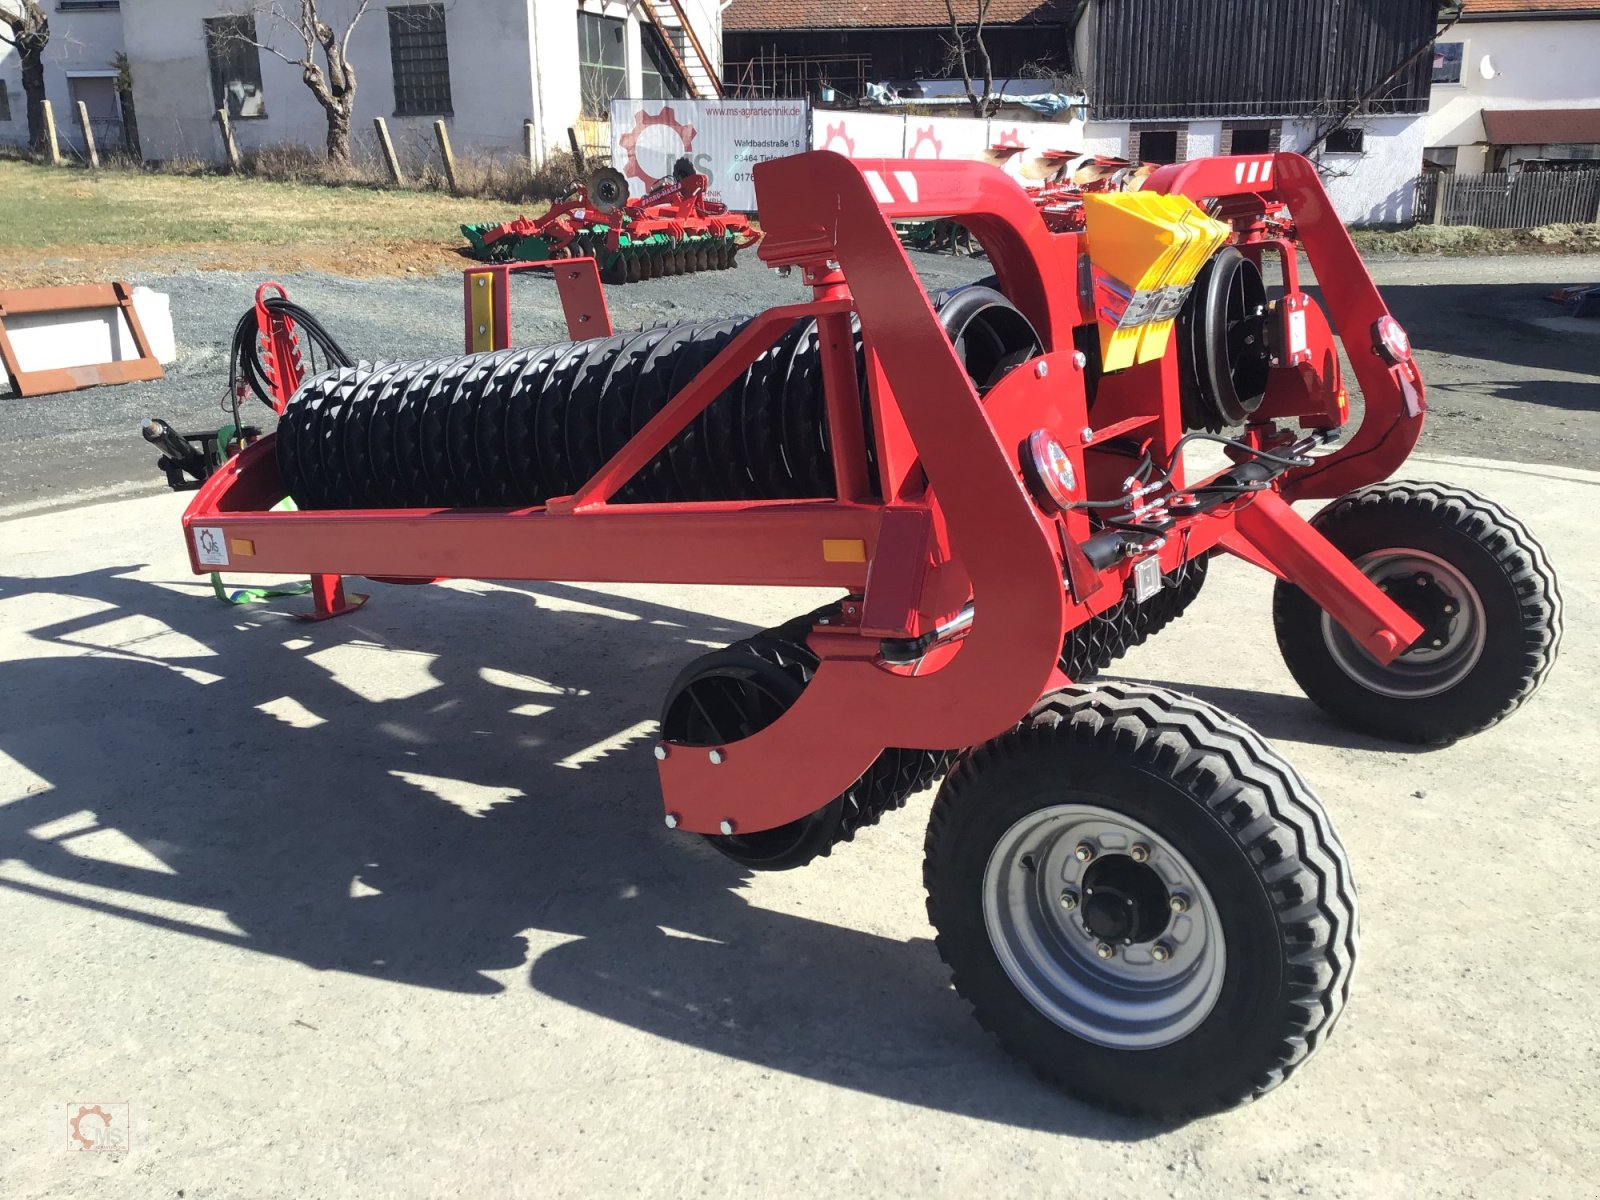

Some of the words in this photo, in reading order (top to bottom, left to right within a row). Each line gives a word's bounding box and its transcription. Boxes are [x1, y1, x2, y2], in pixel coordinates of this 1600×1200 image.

[706, 106, 801, 118] www.ms-agrartechnik.de
[734, 139, 789, 148] Waldbadstraße
[791, 139, 800, 148] 19
